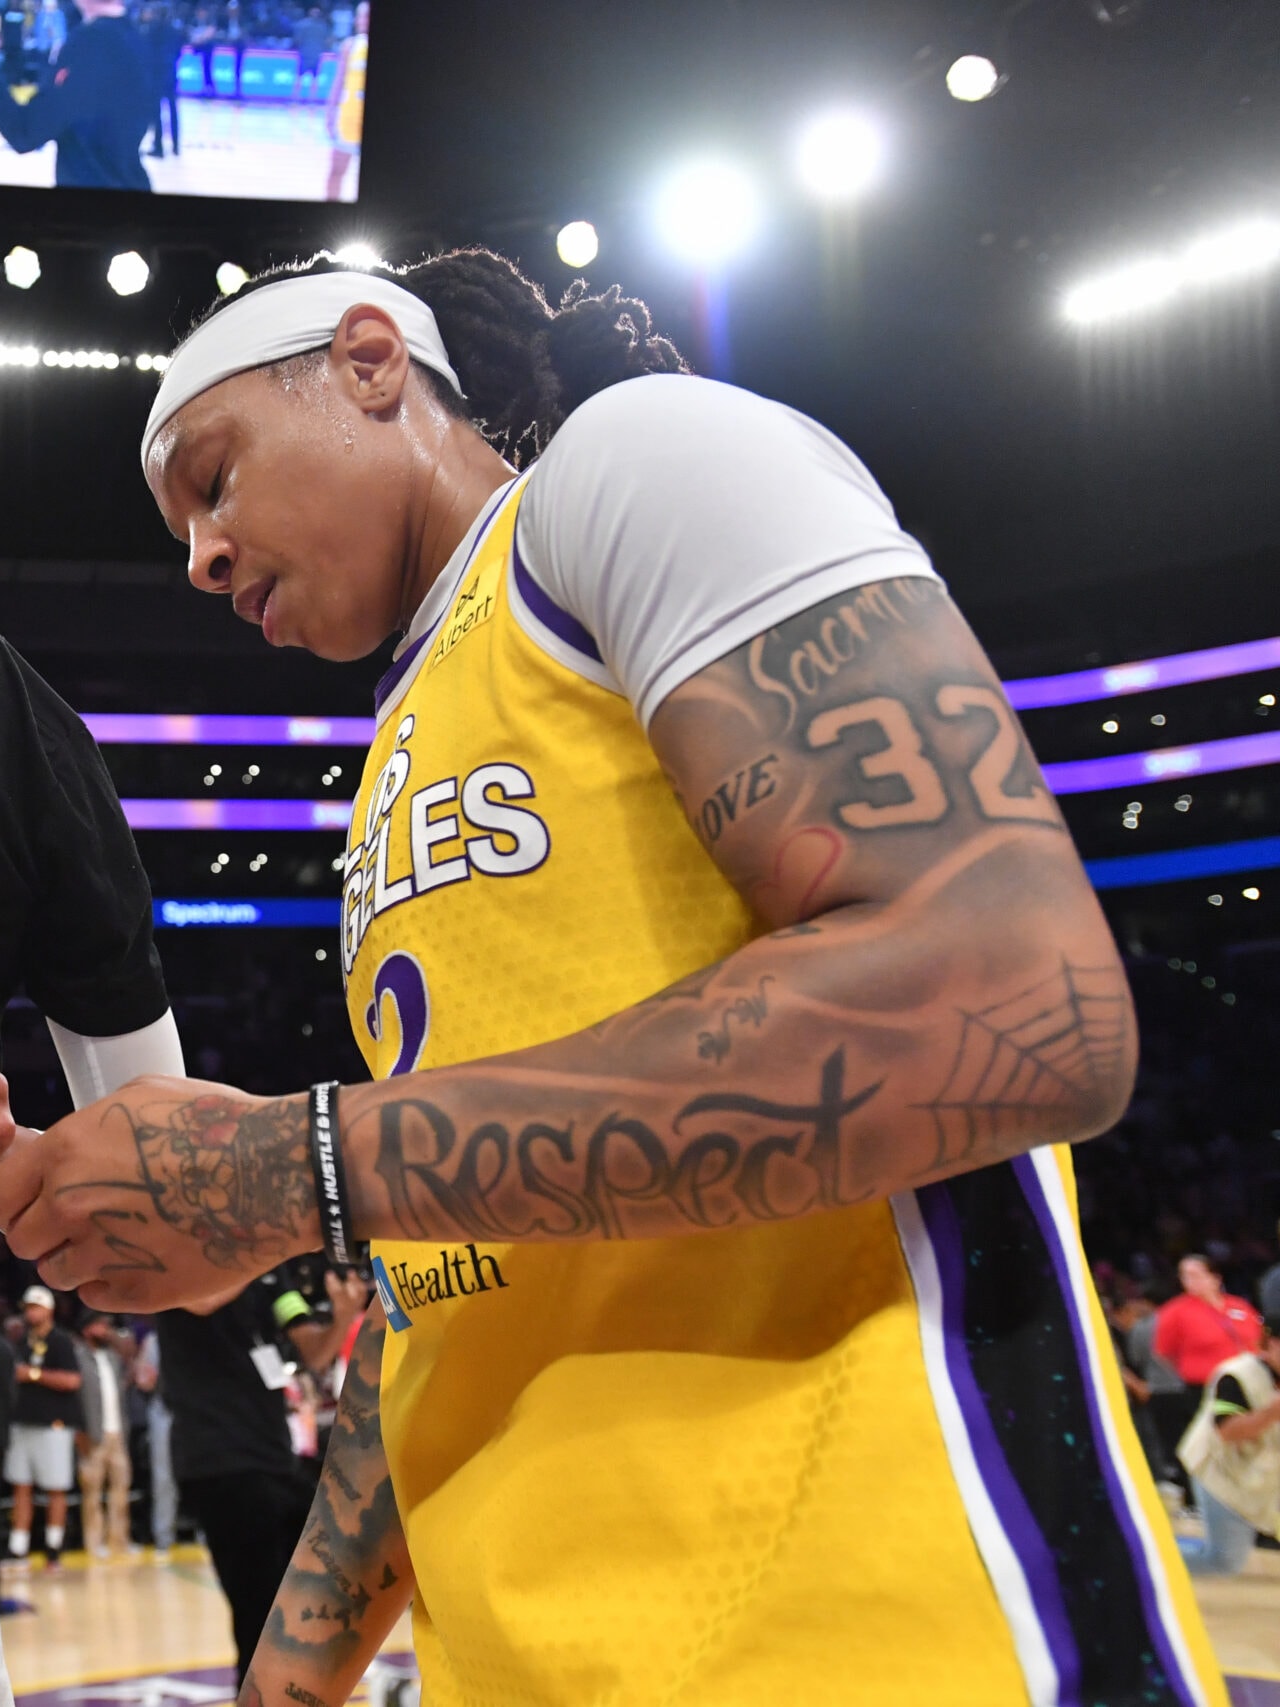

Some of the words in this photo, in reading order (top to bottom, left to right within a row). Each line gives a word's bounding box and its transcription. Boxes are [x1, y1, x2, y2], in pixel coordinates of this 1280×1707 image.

[432, 595, 494, 668] Albert
[804, 682, 1064, 830] 32
[692, 752, 779, 842] OVE
[317, 1129, 339, 1201] HUSTLE
[374, 1043, 887, 1240] Respect
[390, 1243, 510, 1311] Health
